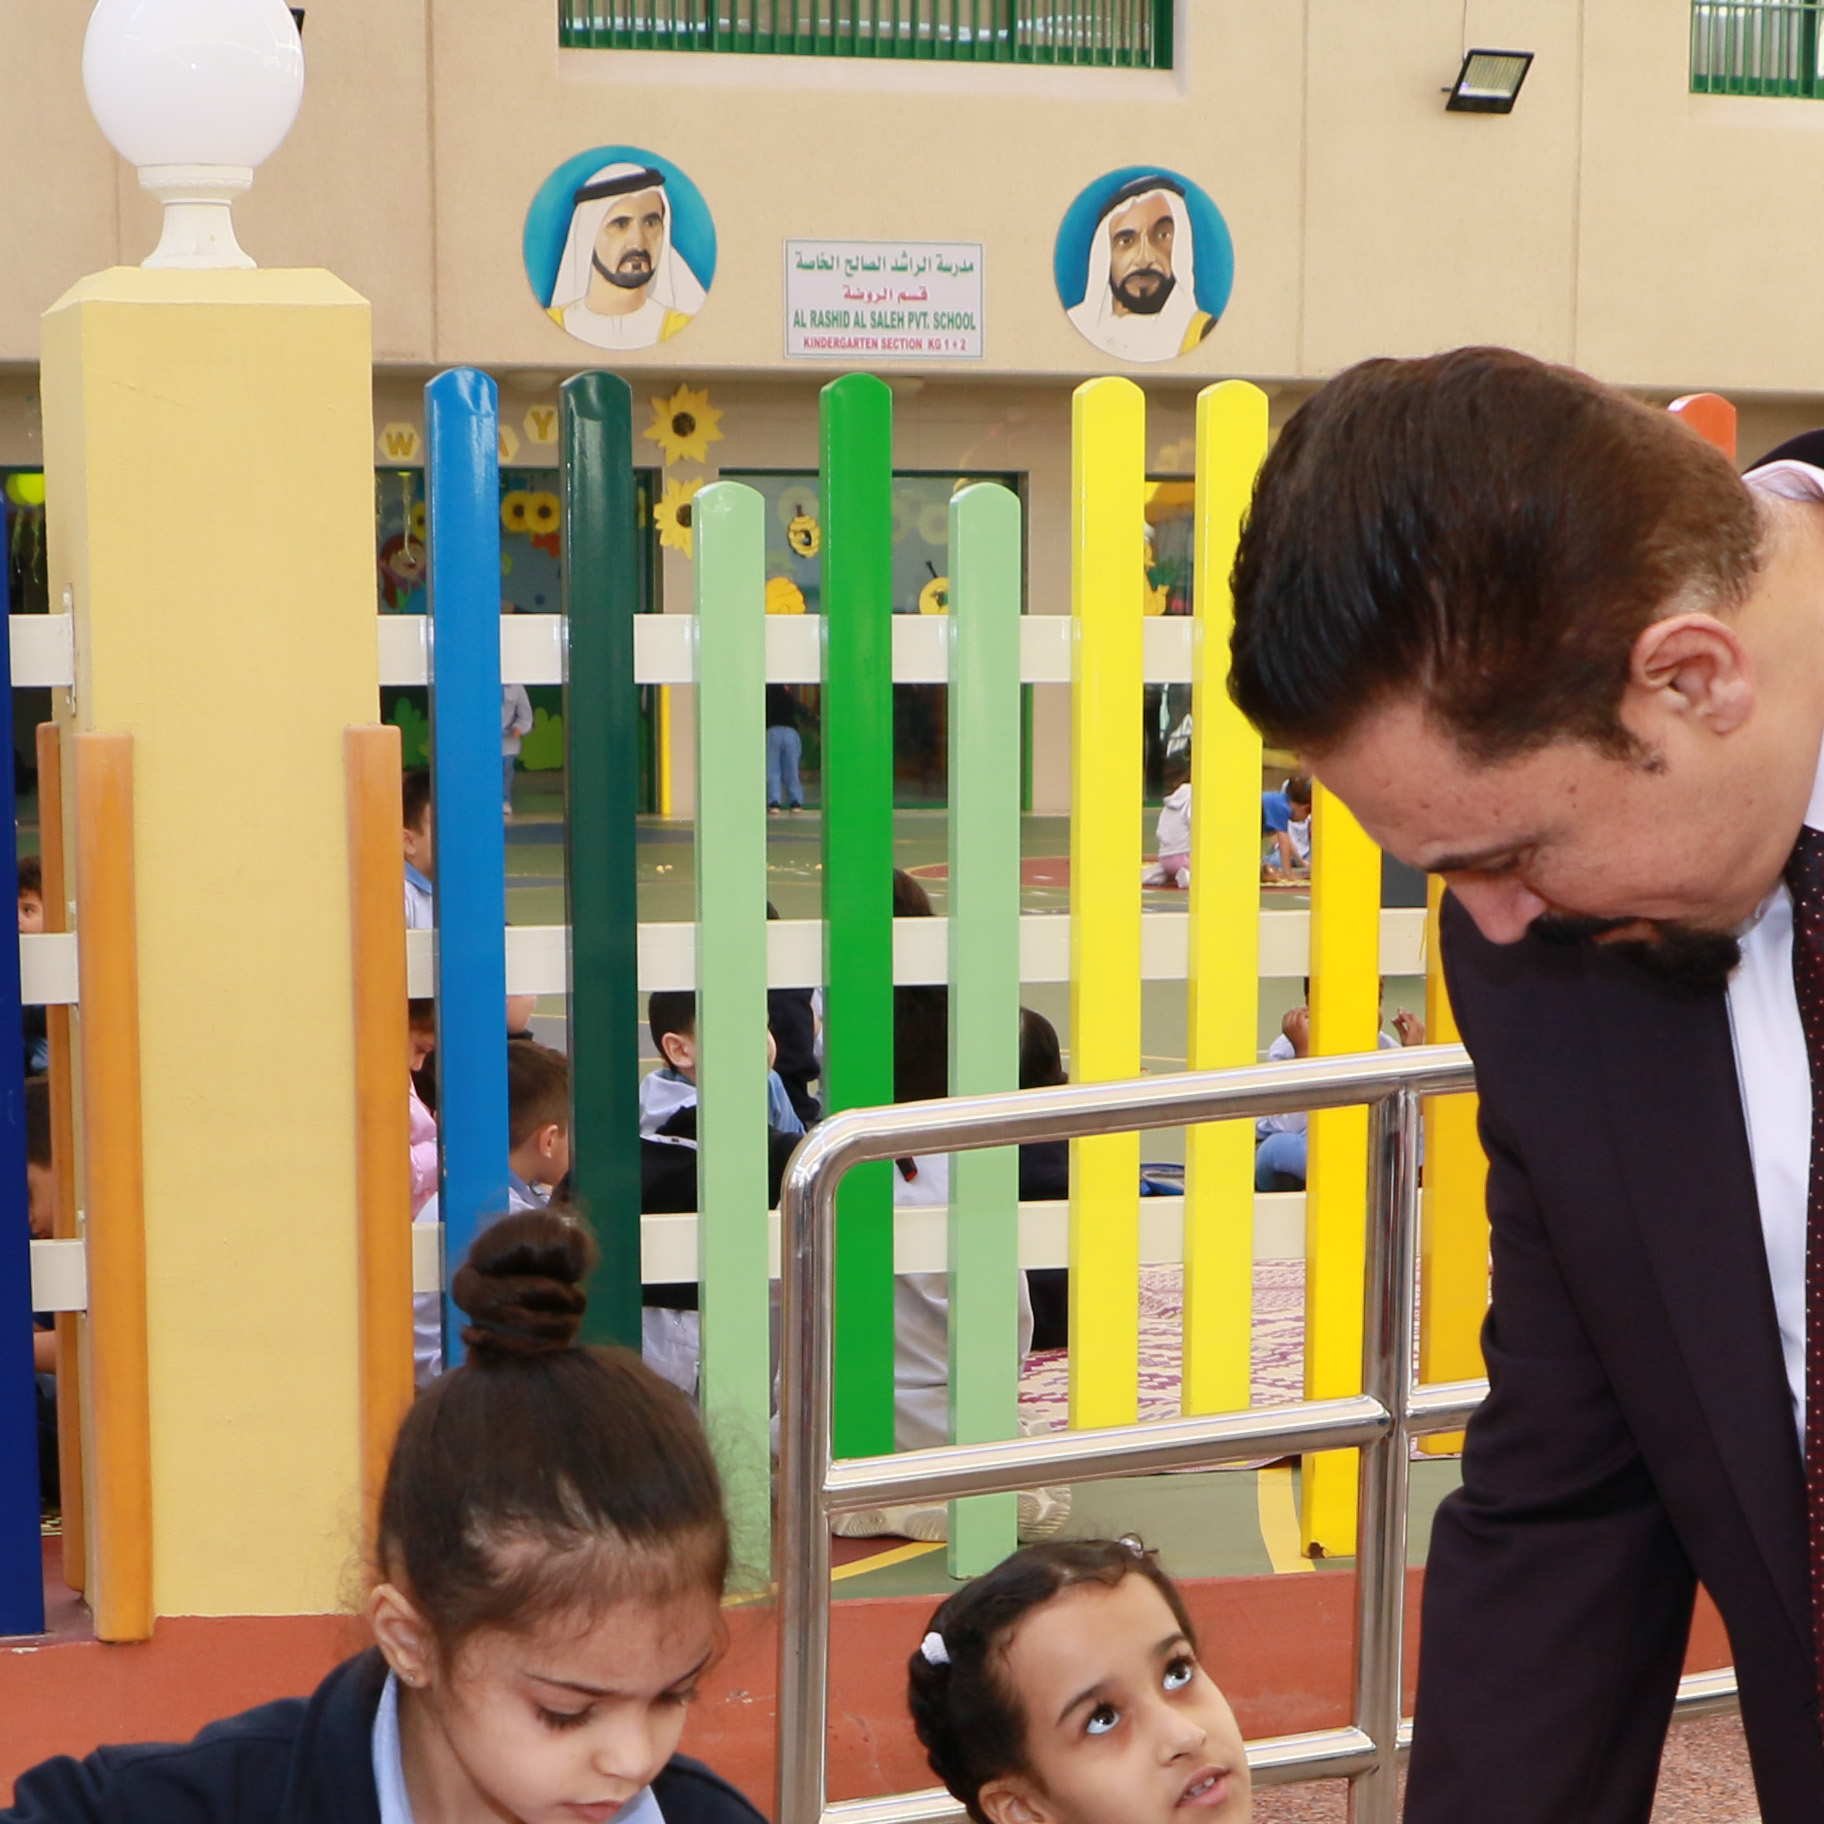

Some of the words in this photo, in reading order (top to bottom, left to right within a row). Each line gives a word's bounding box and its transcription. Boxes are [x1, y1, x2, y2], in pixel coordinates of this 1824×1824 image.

[795, 251, 840, 270] الخاصة
[844, 254, 885, 278] الصالح
[891, 249, 932, 277] الراشد
[936, 253, 974, 277] مدرسة
[842, 284, 893, 304] الروضة
[897, 285, 928, 304] قسم
[793, 310, 807, 328] AL
[810, 310, 850, 328] RASHID
[853, 310, 867, 328] AL
[870, 311, 904, 329] SALEH
[907, 311, 930, 329] PVT.
[933, 311, 976, 330] SCHOOL
[803, 336, 878, 349] KINDERGARTEN
[881, 337, 923, 350] SECTION
[928, 338, 942, 350] KG
[960, 338, 967, 350] 2
